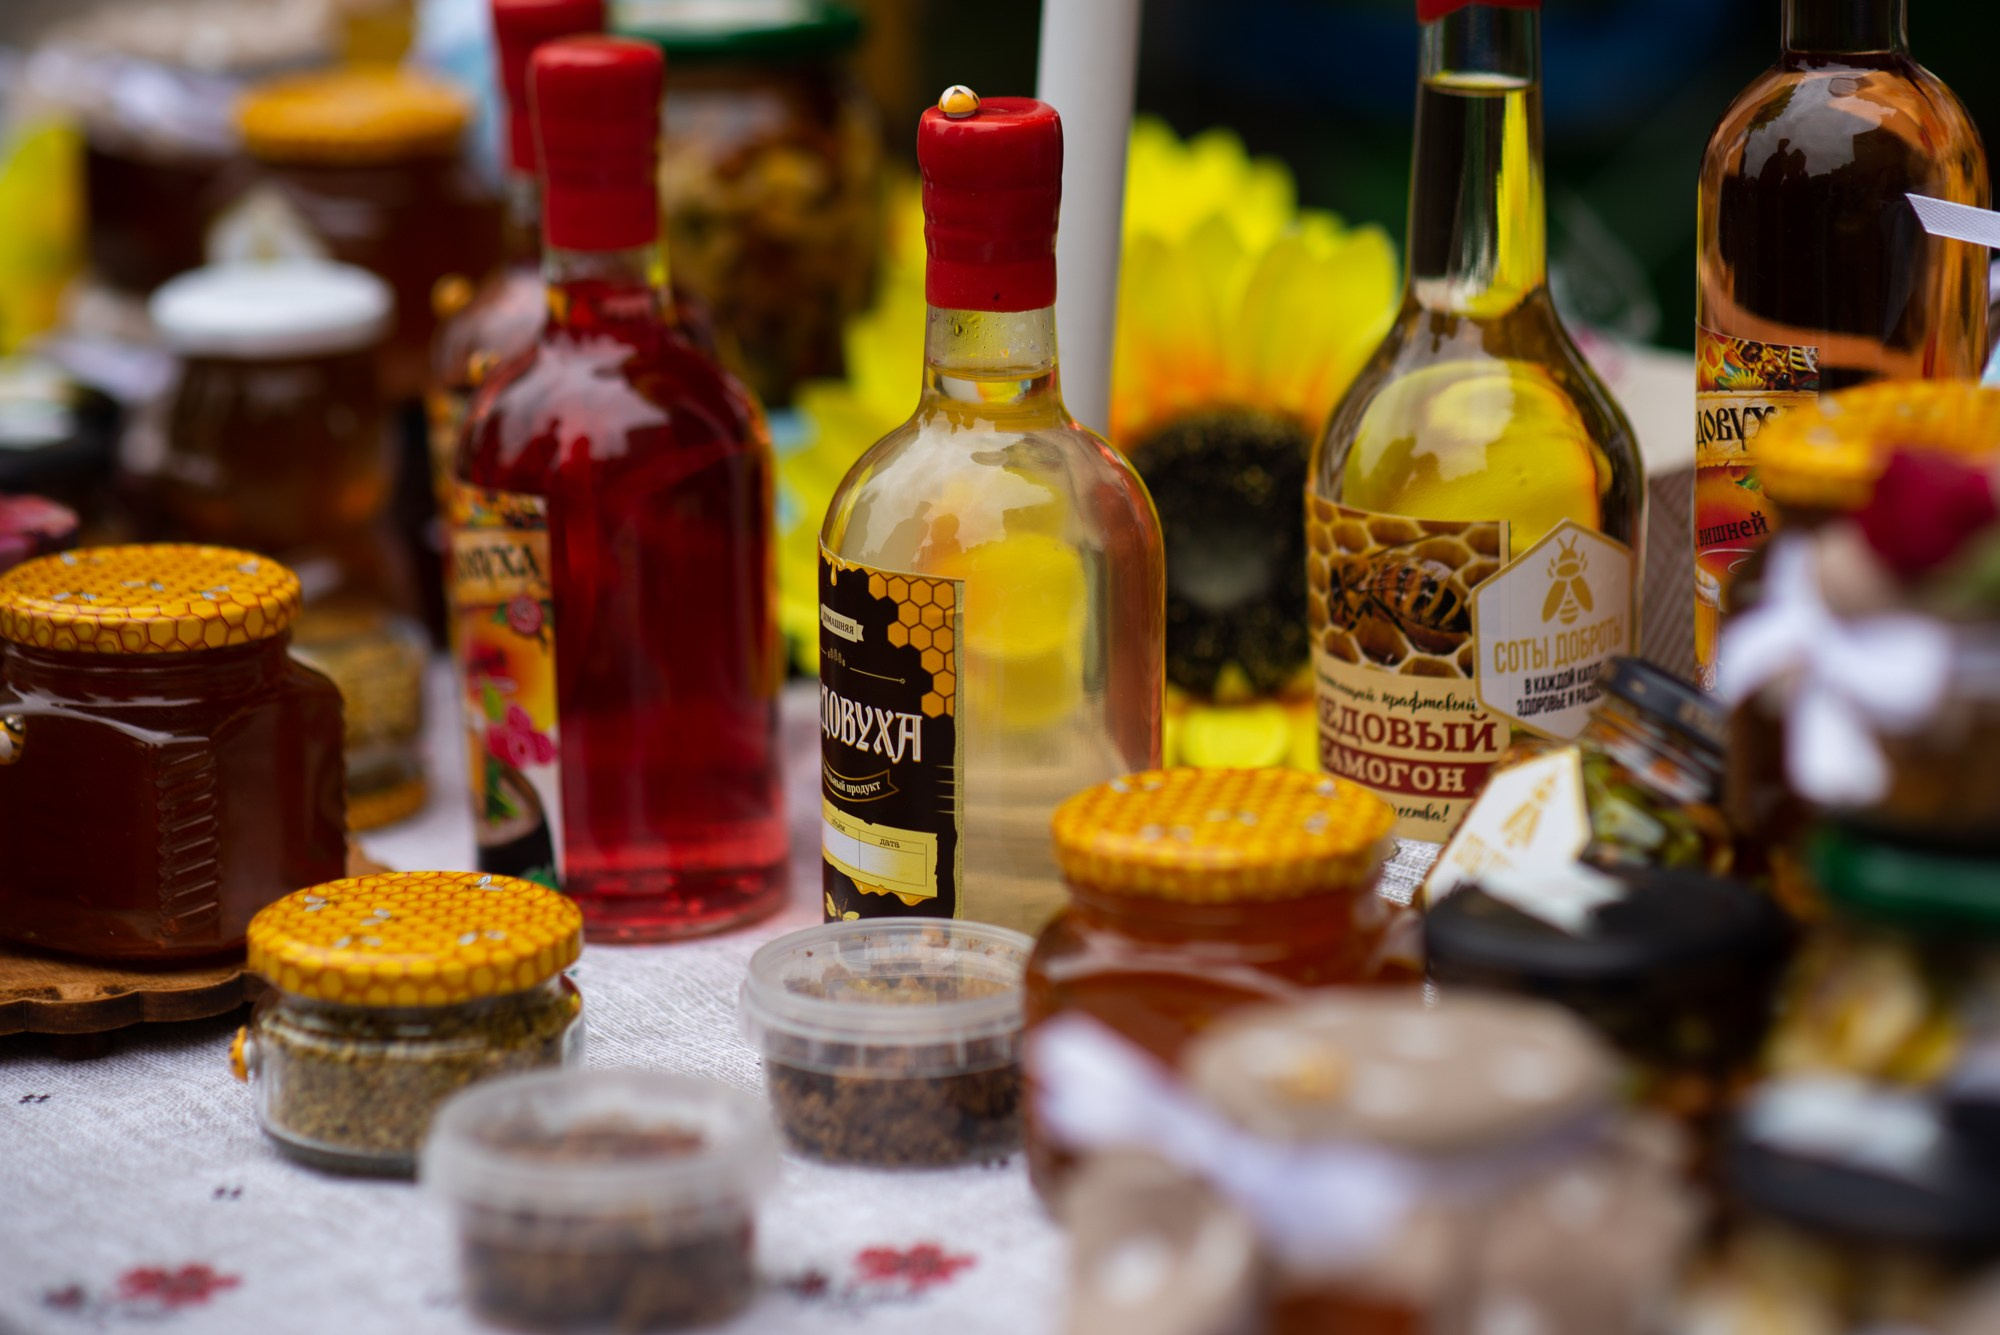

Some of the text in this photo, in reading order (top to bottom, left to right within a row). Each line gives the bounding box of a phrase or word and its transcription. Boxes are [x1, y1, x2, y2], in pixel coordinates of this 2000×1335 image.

[1696, 405, 1797, 451] ДОВУХ
[1700, 510, 1770, 548] вишней
[1493, 613, 1624, 674] СОТЫ ДОБРОТЫ
[1525, 660, 1604, 695] В КАЖДОЙ КАП
[1381, 691, 1478, 714] крафтовый
[1517, 692, 1567, 717] ЗДОРОВЬЕ
[820, 682, 923, 765] ДОВУХА
[1321, 692, 1498, 753] ЕДОВЫЙ
[846, 781, 881, 797] продукт
[879, 837, 901, 849] дата
